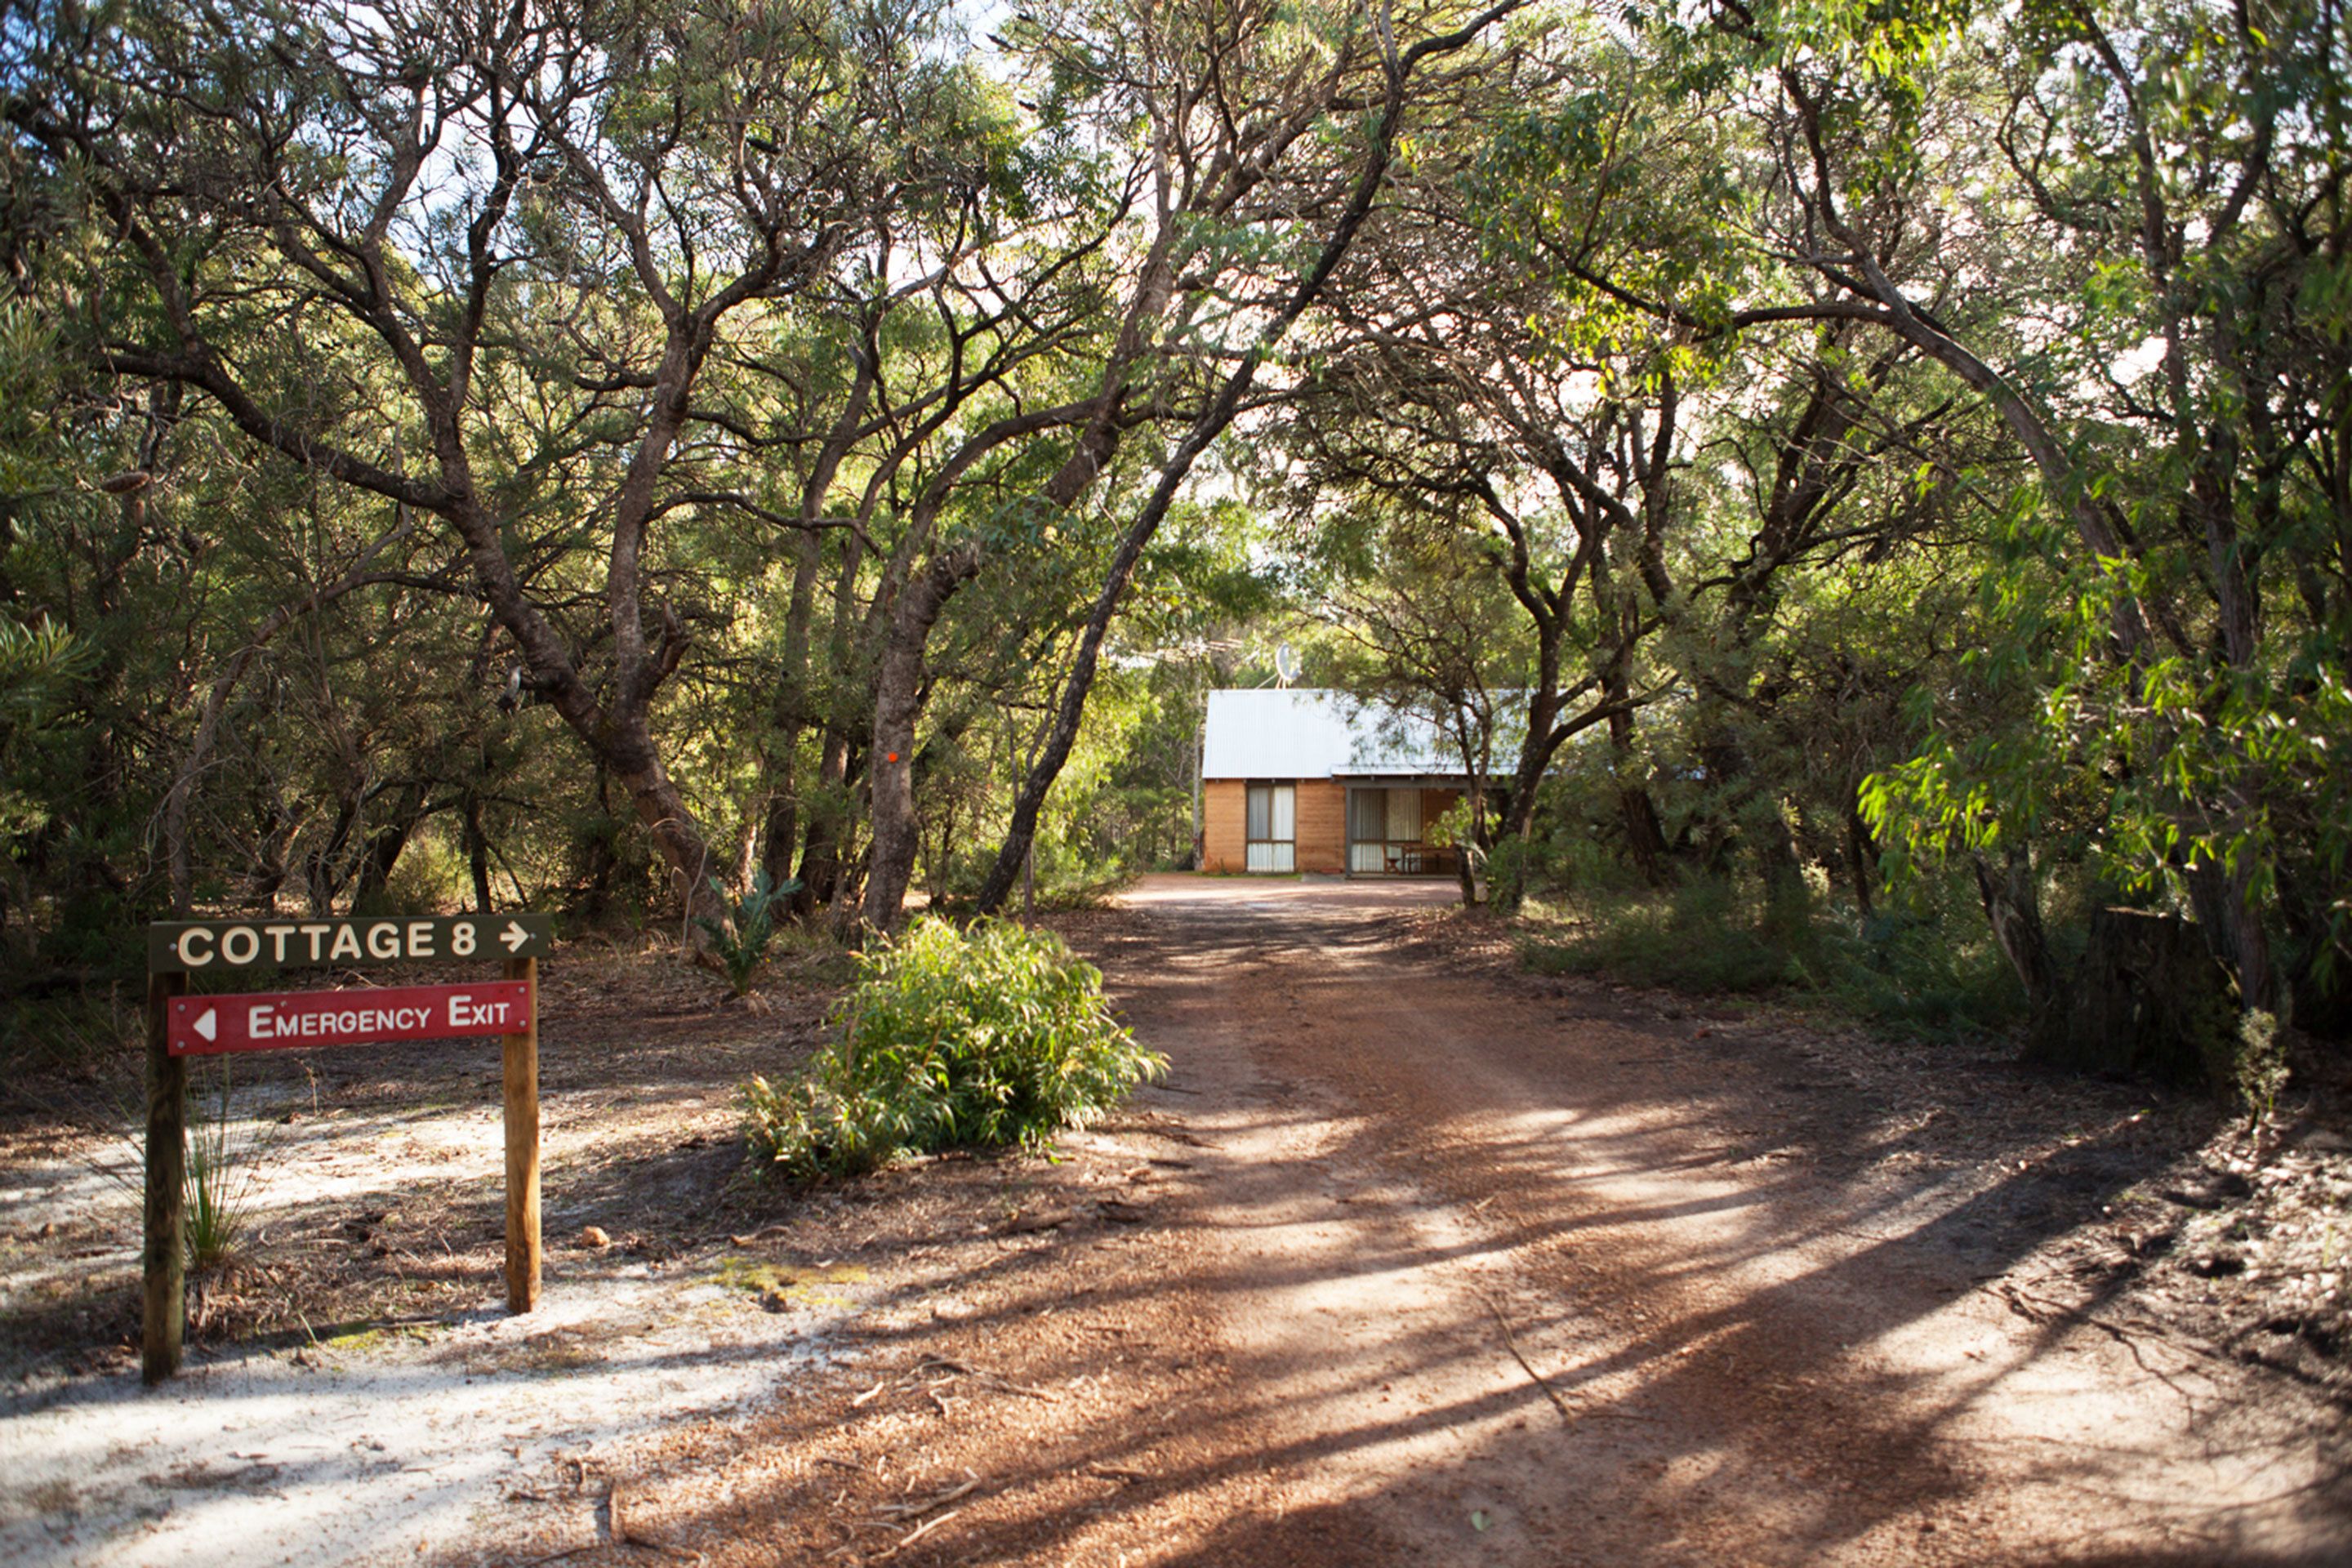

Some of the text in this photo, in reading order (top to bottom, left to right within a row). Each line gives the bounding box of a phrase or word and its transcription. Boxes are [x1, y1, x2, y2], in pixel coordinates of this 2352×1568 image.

[177, 921, 477, 966] COTTAGE 8
[248, 996, 510, 1039] EMERGENCY EXIT
